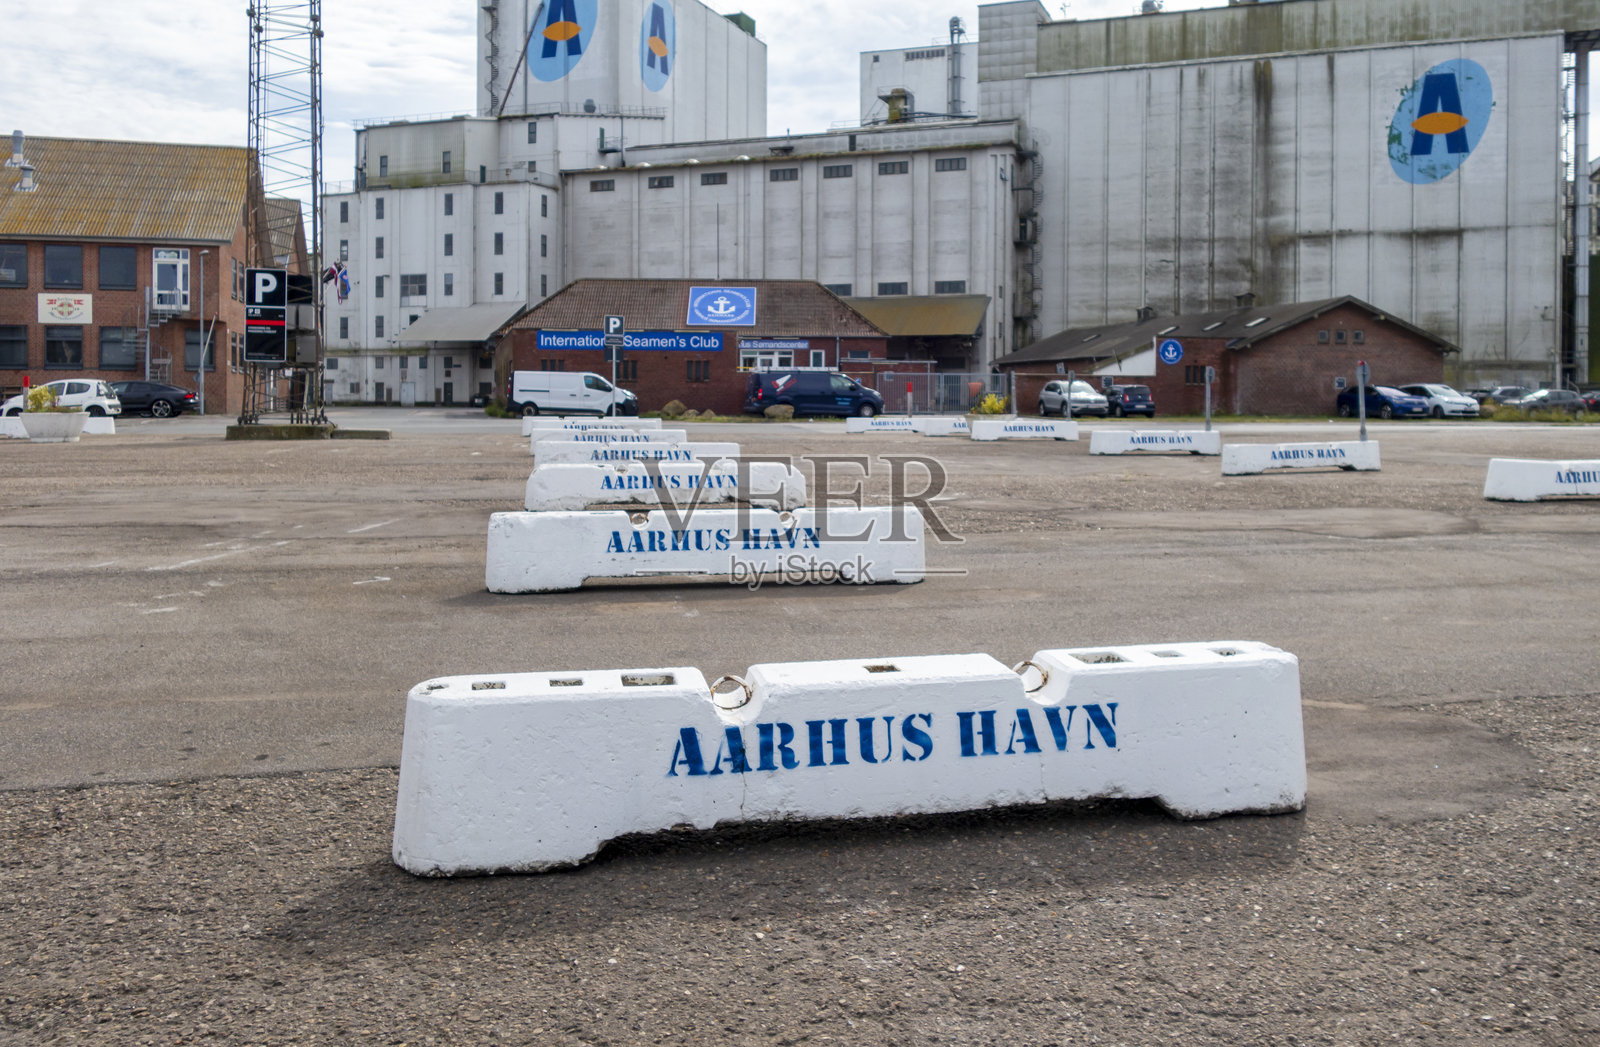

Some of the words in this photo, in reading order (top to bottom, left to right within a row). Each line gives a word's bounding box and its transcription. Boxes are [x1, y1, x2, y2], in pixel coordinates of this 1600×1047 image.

[255, 272, 278, 303] P
[609, 317, 621, 334] P
[624, 336, 687, 348] Seamen's
[690, 336, 719, 348] Club
[1003, 424, 1034, 432] AARHUS
[1035, 424, 1056, 432] HAVN
[1129, 436, 1167, 445] AARHUS
[1168, 436, 1193, 445] HAVN
[590, 449, 649, 461] AARHUS
[653, 449, 692, 461] HAVN
[1270, 448, 1315, 460] AARHUS
[1316, 448, 1346, 459] HAVN
[600, 474, 681, 489] AARHUS
[687, 474, 738, 489] HAVN
[607, 528, 731, 553] AARHUS
[742, 527, 823, 550] HAVN
[665, 712, 934, 777] AARHUS
[954, 702, 1120, 758] HAVN
